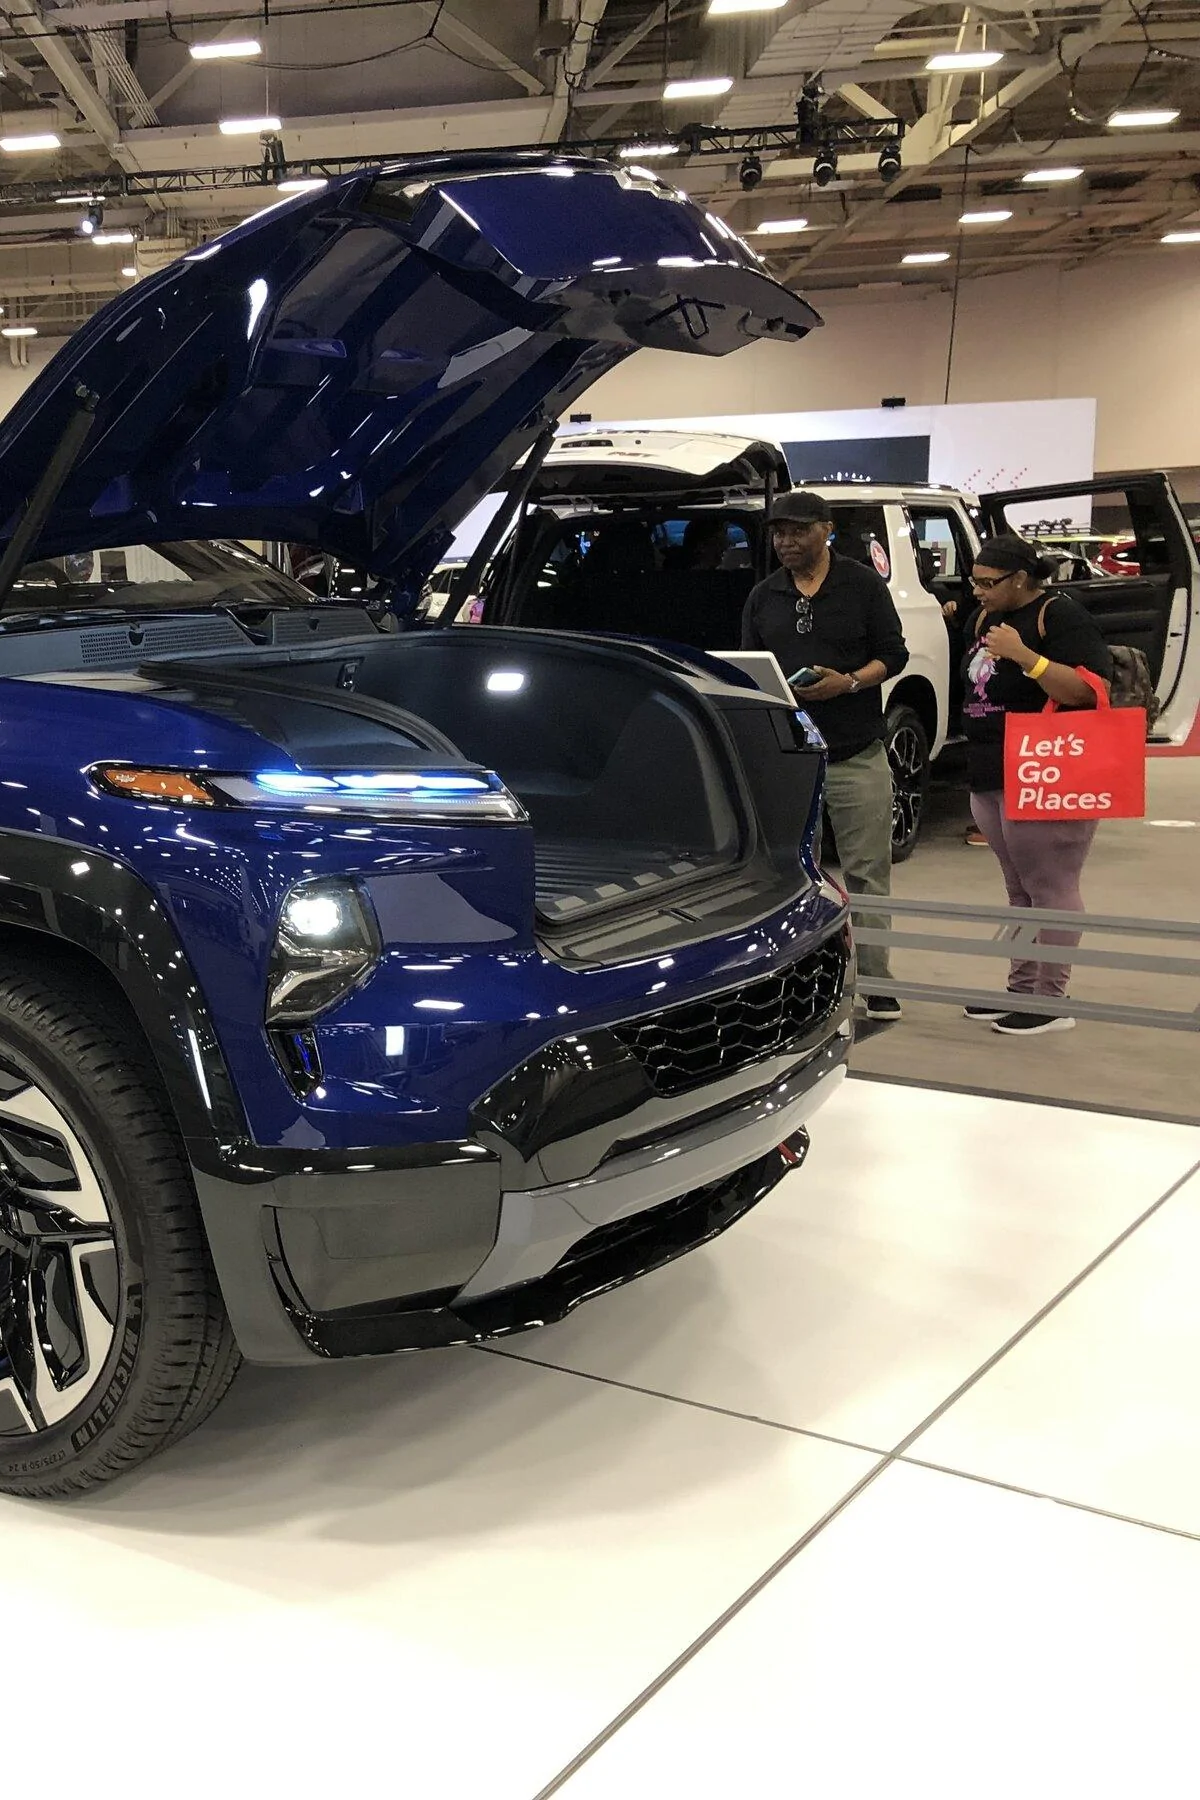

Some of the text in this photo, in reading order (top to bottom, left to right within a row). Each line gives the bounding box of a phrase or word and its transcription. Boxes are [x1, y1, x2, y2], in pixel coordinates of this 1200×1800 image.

[1018, 733, 1085, 757] Let's
[1017, 761, 1061, 784] Go
[1017, 787, 1112, 810] Places
[74, 1327, 140, 1447] MICHELIN
